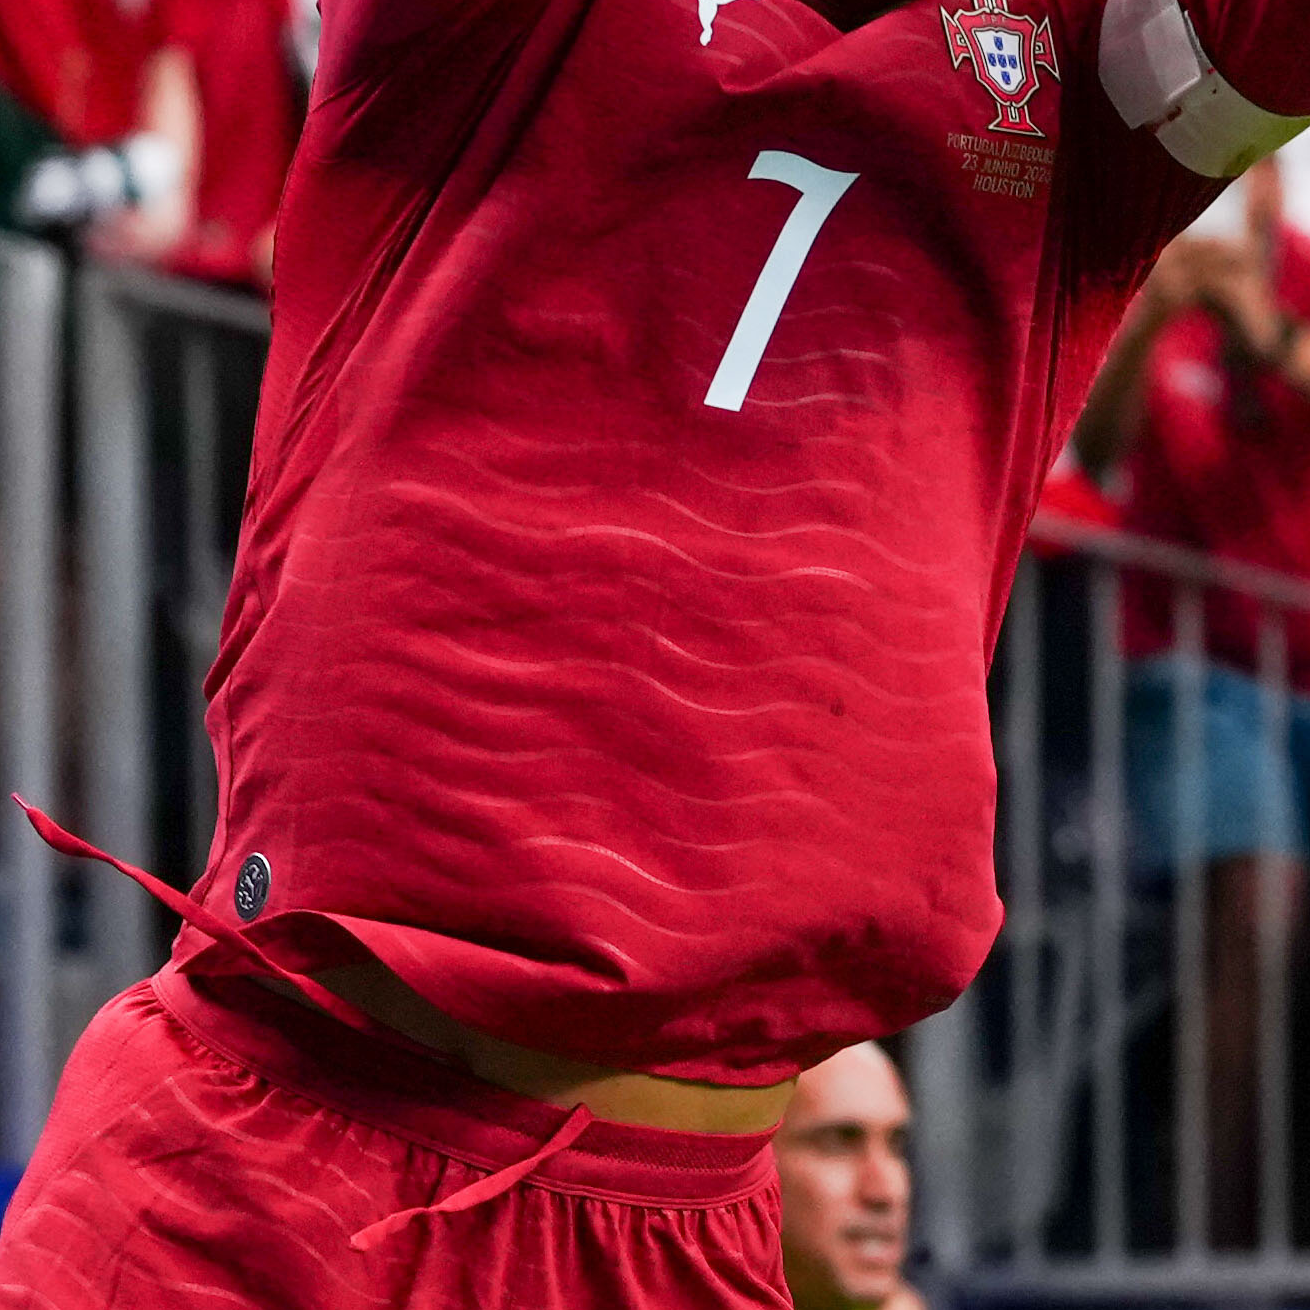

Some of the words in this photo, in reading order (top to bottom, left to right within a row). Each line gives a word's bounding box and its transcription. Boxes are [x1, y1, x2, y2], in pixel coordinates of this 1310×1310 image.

[961, 152, 978, 170] 23
[980, 157, 1020, 177] JUNHO
[972, 173, 1035, 199] HOUSTON
[703, 150, 861, 412] 7
